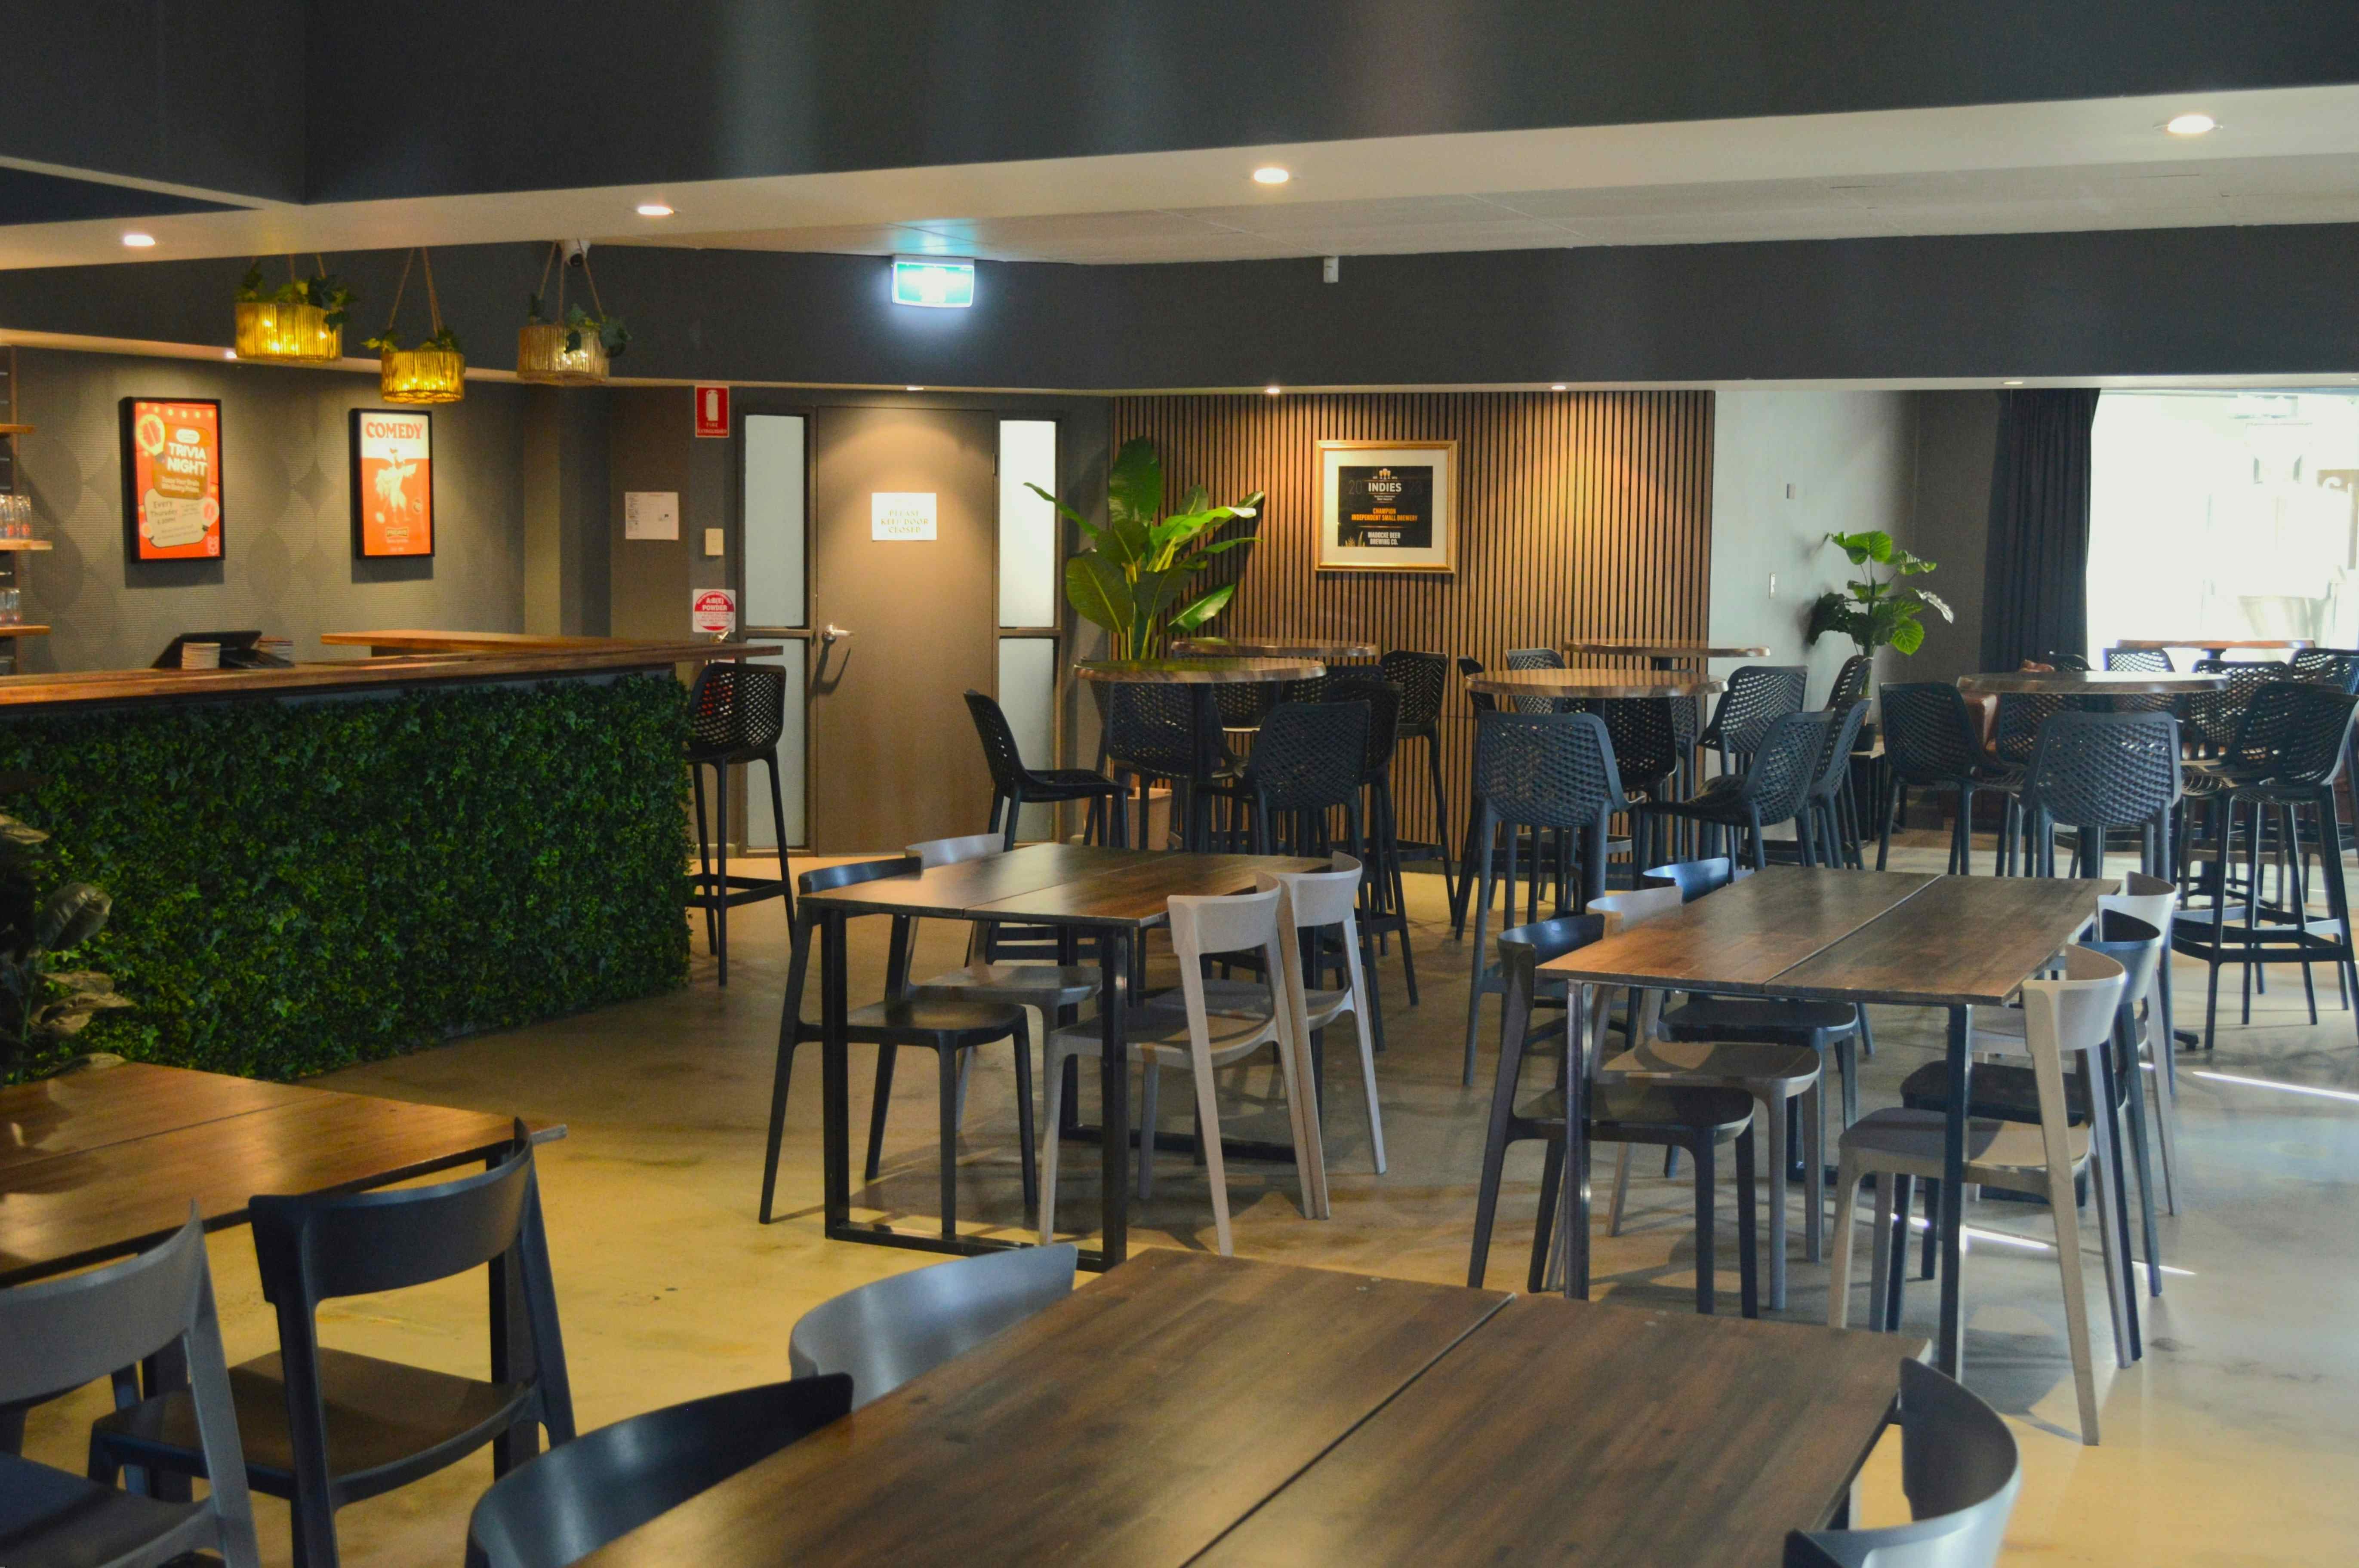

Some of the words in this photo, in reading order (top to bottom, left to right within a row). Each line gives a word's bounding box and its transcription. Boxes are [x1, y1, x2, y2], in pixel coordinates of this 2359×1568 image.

[366, 421, 423, 440] COMEDY
[168, 442, 206, 460] TRIVIA
[166, 457, 208, 476] NIGHT
[1349, 479, 1363, 495] 20
[1368, 482, 1402, 492] INDIES
